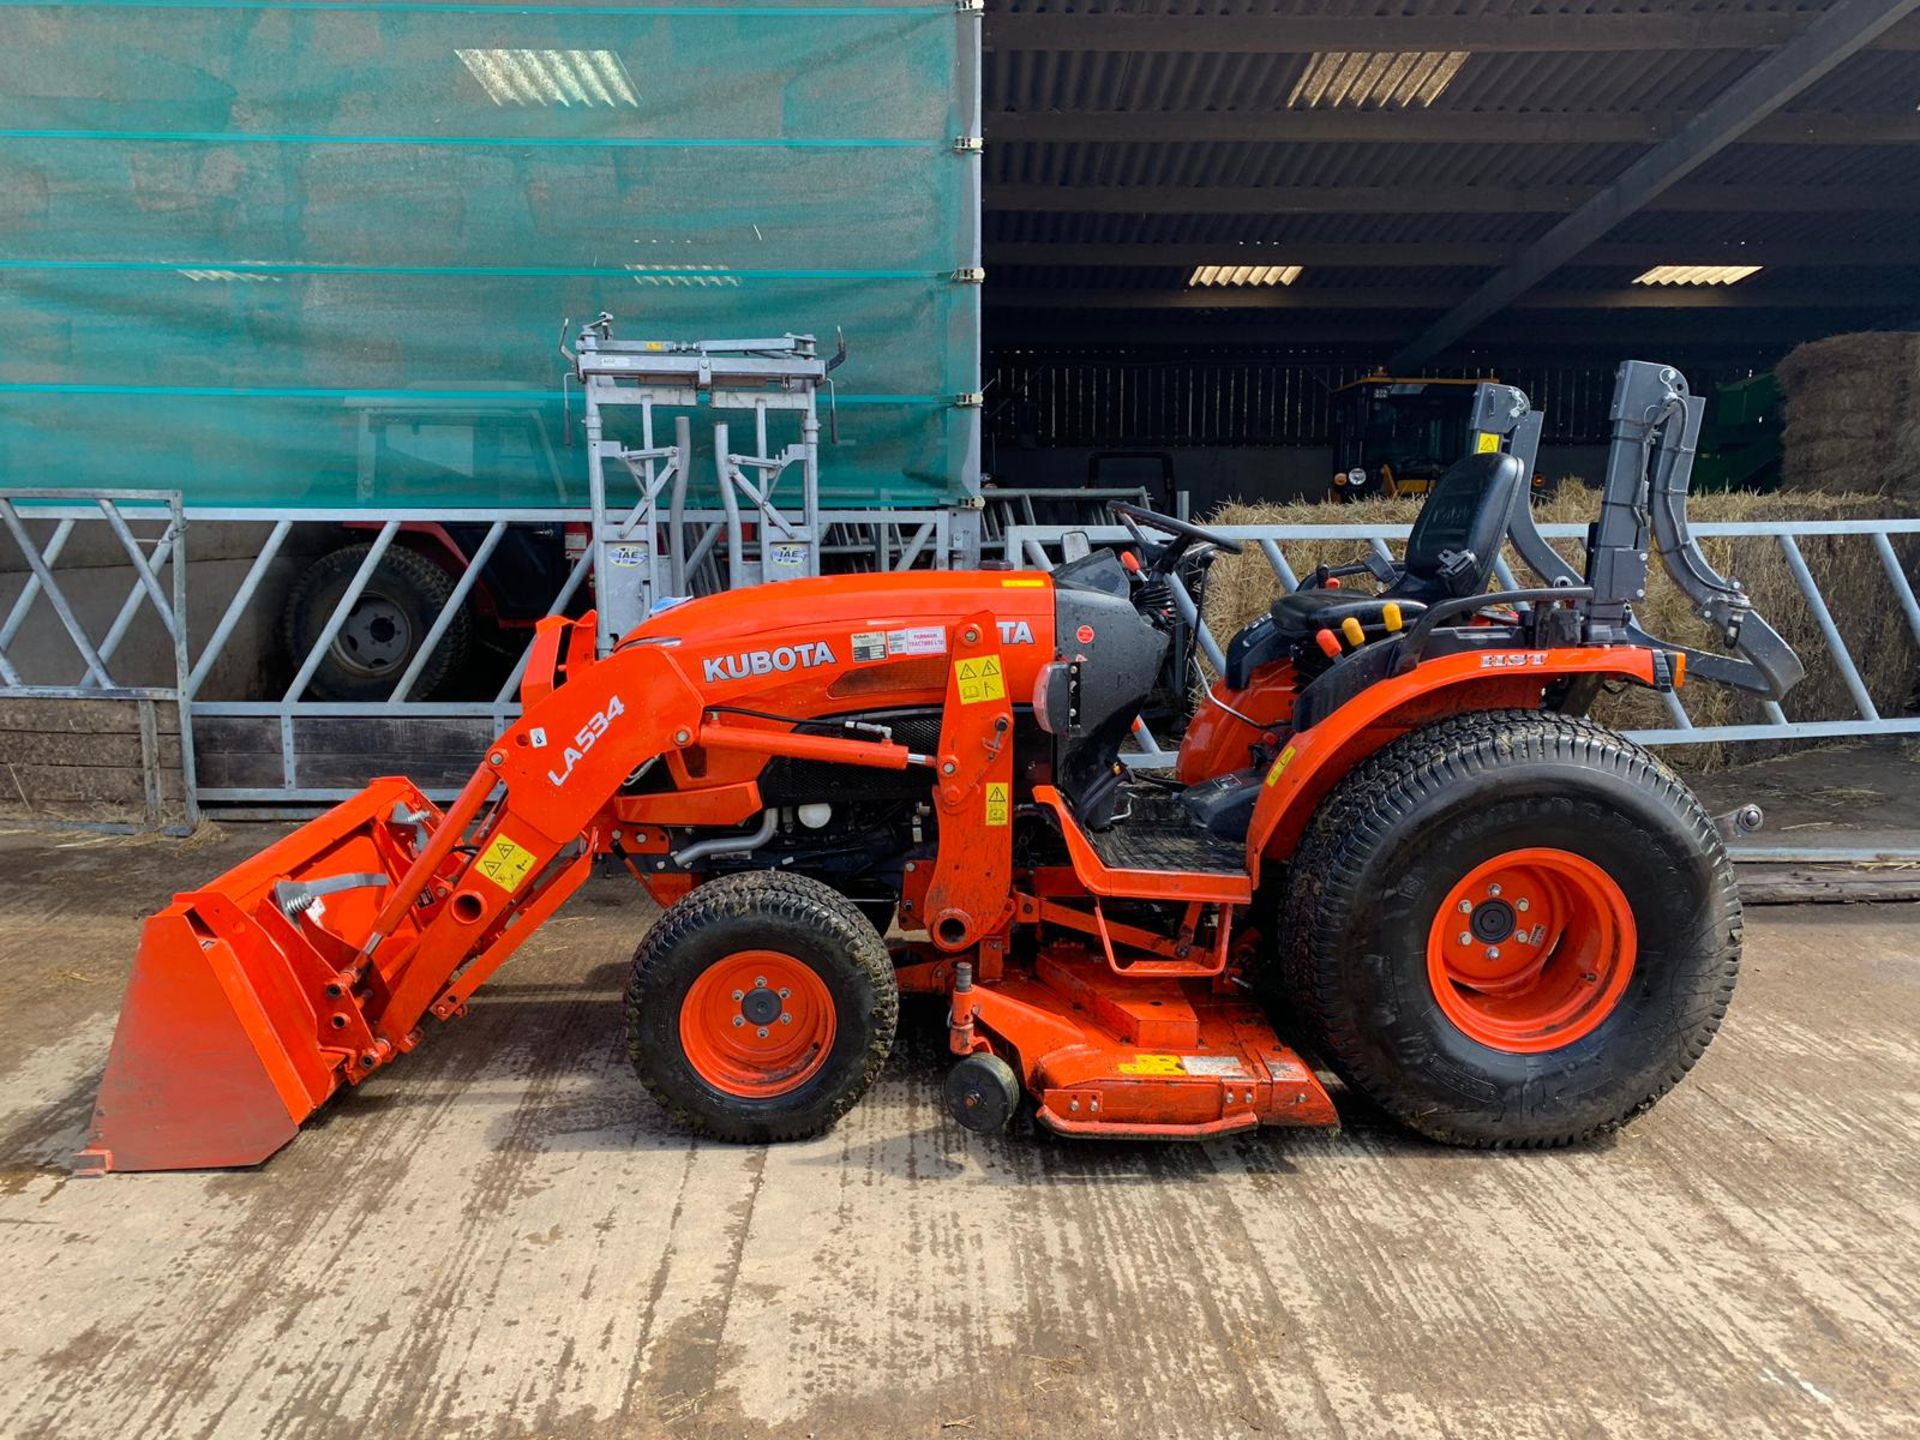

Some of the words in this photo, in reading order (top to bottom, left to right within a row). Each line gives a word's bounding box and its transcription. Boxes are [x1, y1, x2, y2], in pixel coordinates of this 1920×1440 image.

[618, 551, 639, 559] IAE
[779, 550, 801, 558] IAE
[702, 640, 837, 682] KUBOTA
[1480, 653, 1549, 668] HST
[547, 694, 625, 786] LA534
